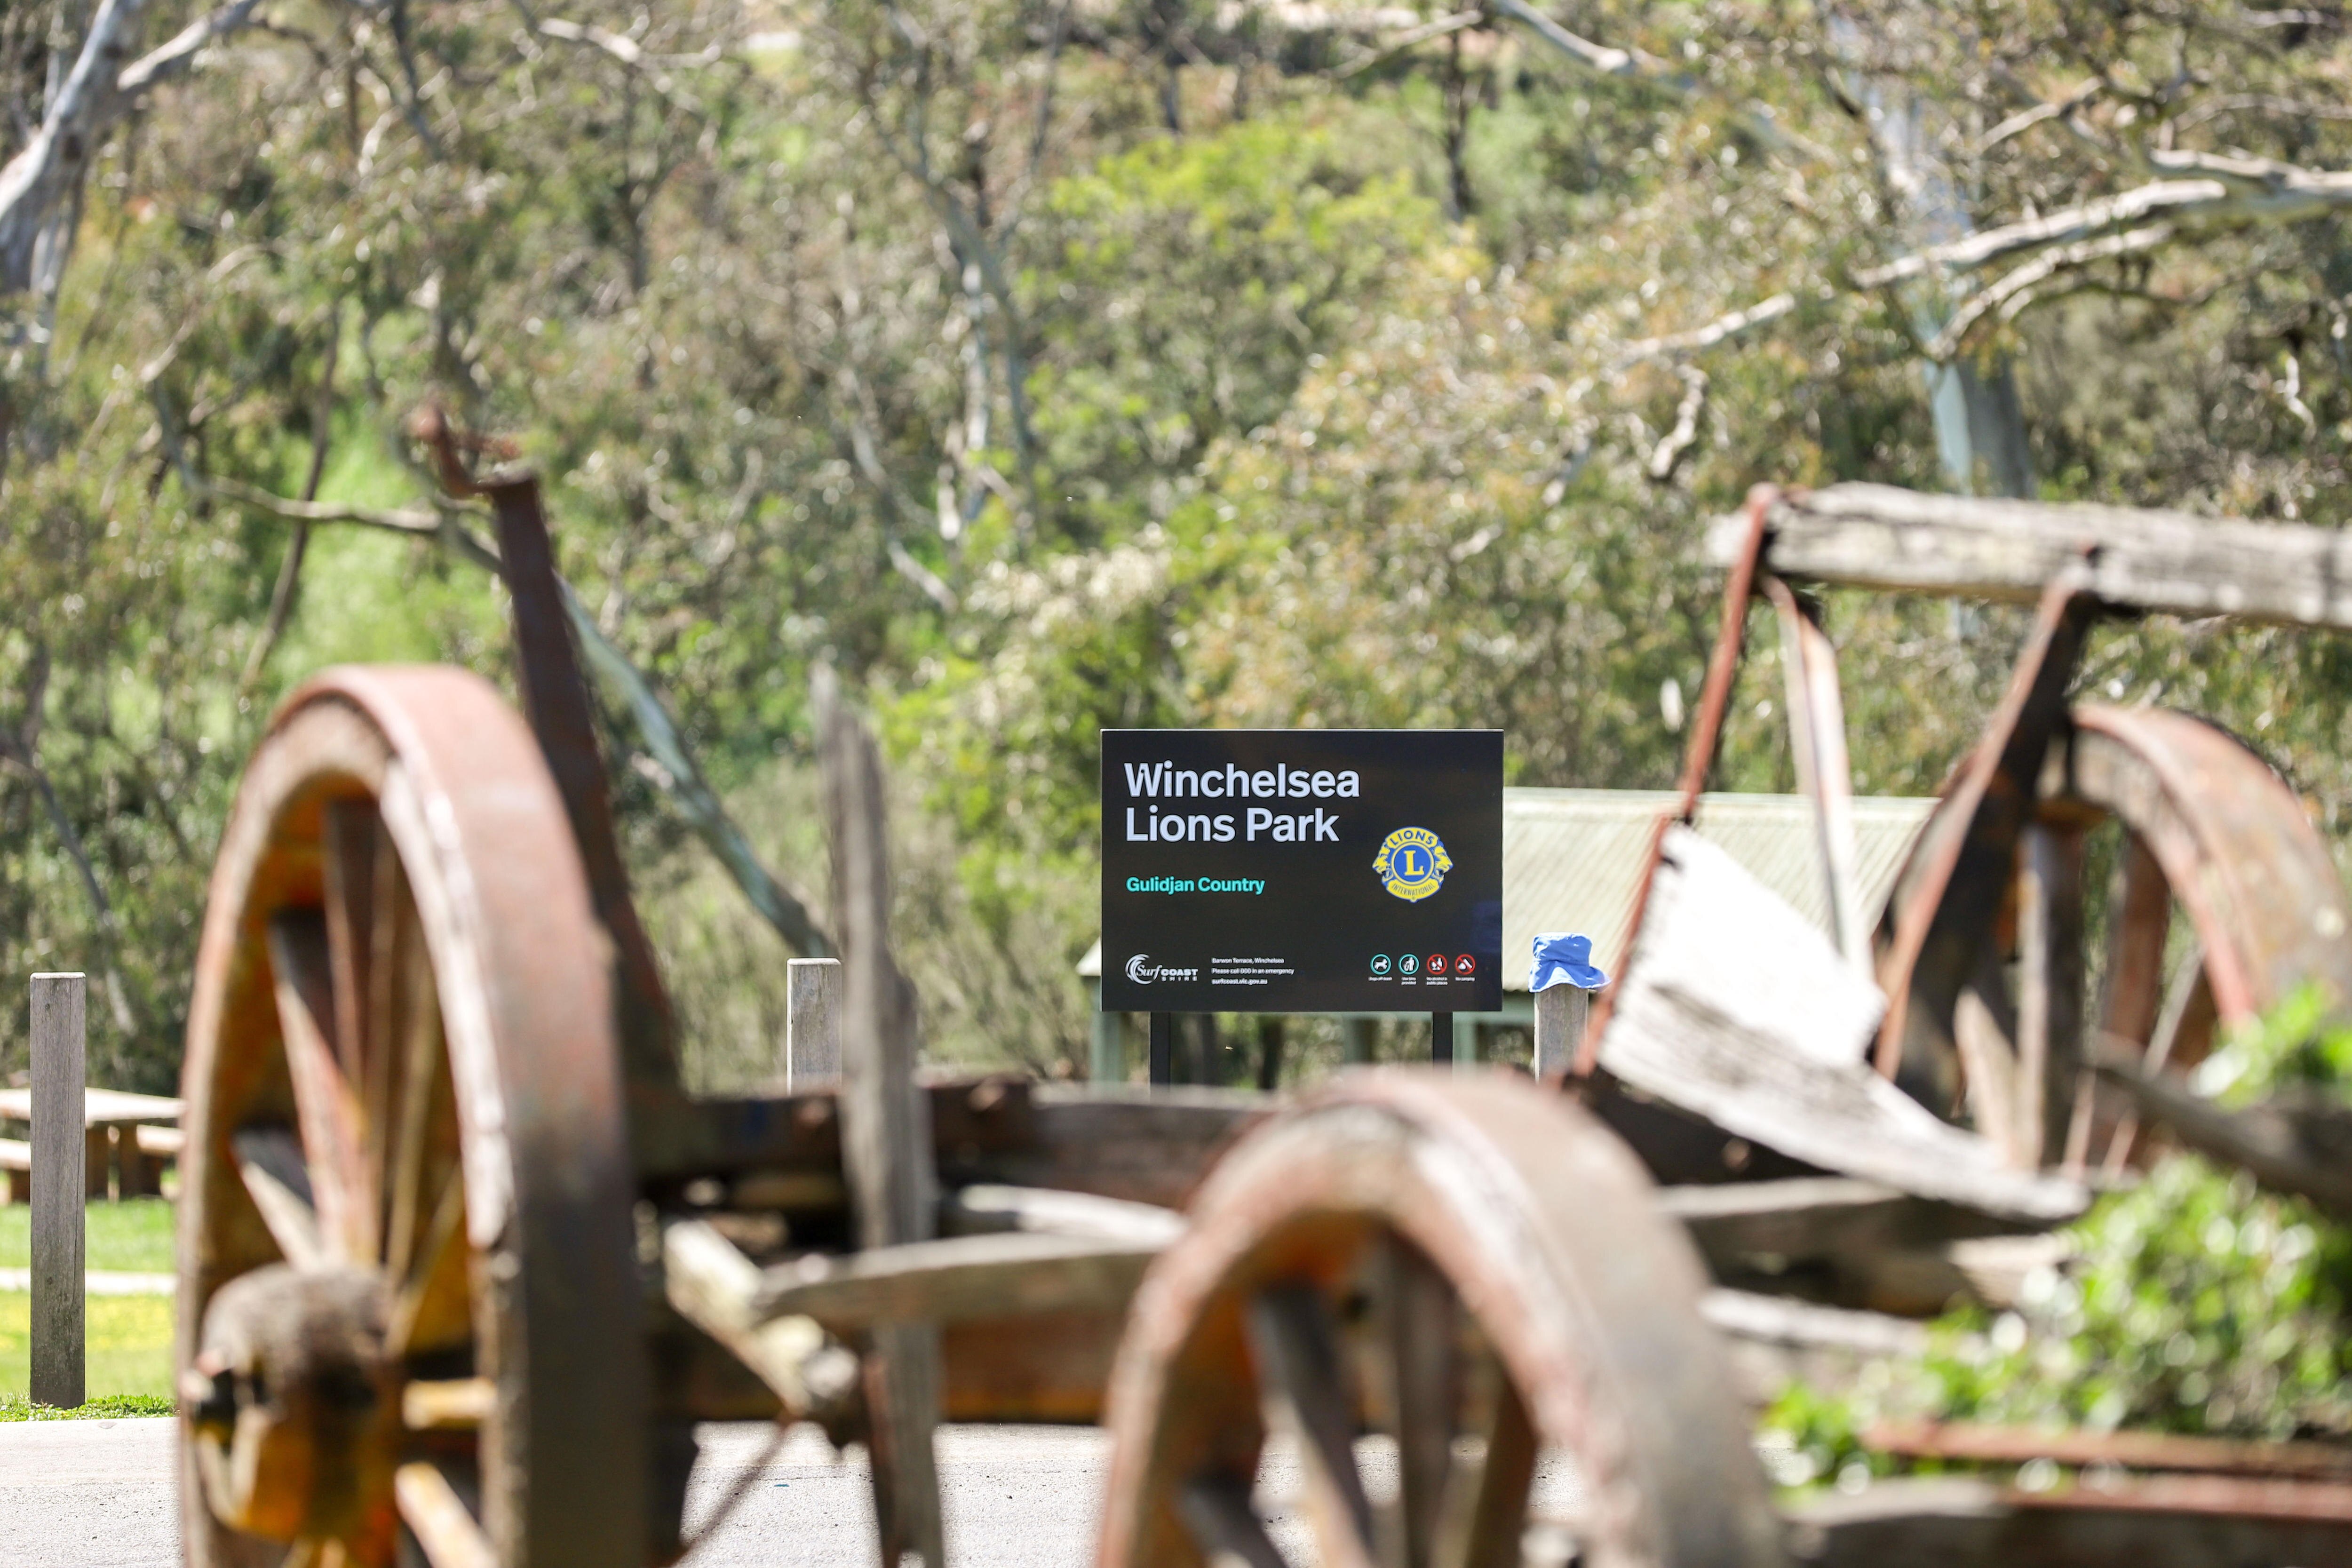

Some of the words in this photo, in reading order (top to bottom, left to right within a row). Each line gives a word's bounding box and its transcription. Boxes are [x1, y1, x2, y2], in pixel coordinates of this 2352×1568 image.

[1124, 760, 1360, 798] Winchelsea
[1126, 804, 1236, 842] Lions
[1246, 807, 1340, 842] Park
[1389, 830, 1435, 845] LIONS
[1404, 850, 1425, 876] L
[1126, 876, 1195, 895] Gulidjan
[1197, 876, 1265, 895] Country
[1391, 883, 1436, 896] INTERNATIONAL
